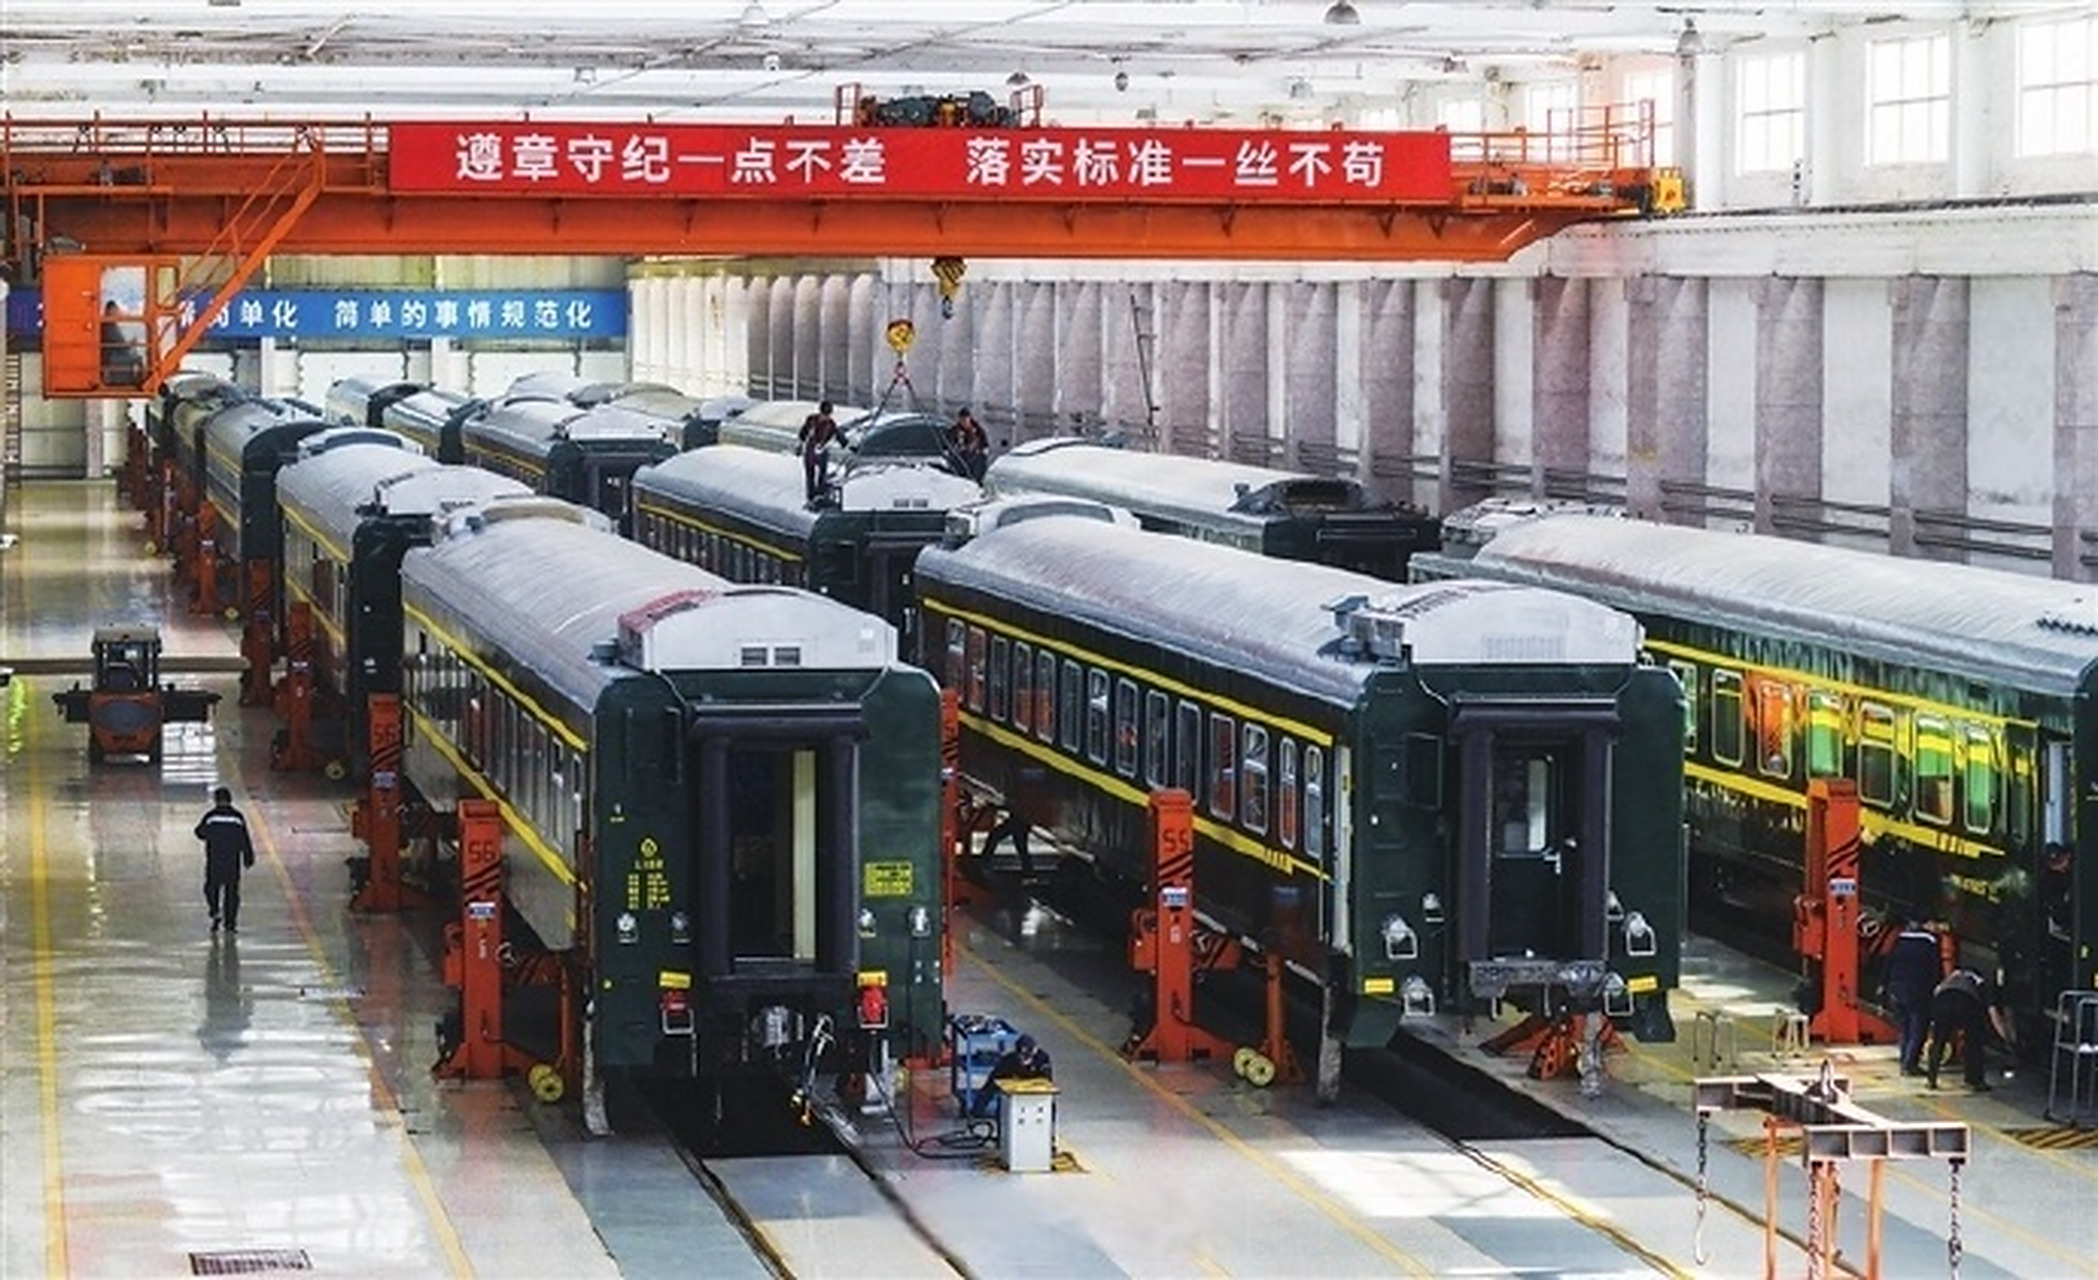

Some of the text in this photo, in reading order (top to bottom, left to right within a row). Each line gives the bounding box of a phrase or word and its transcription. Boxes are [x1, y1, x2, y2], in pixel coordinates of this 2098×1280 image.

[456, 133, 1385, 188] 遵章守纪一点不差 落实标准一丝不苟
[335, 300, 592, 329] 简单的事情规范化
[468, 840, 497, 864] 56
